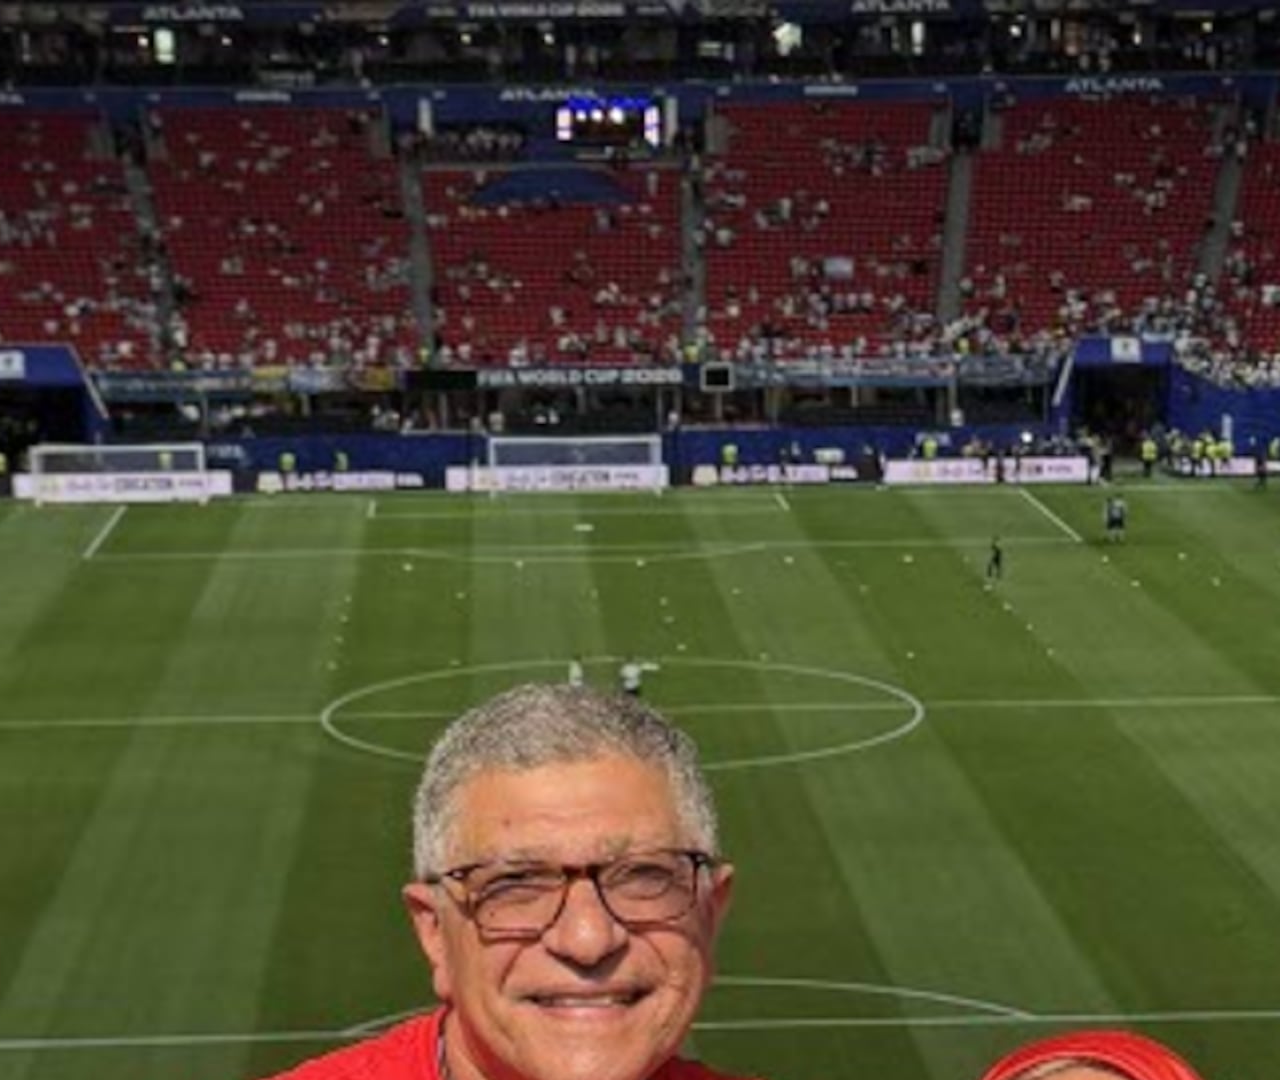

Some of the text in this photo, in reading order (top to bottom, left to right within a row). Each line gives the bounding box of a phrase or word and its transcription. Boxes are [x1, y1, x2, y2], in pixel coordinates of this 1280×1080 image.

[1064, 77, 1164, 93] ATLANTA
[517, 368, 583, 385] WORLD
[584, 368, 620, 385] CUP
